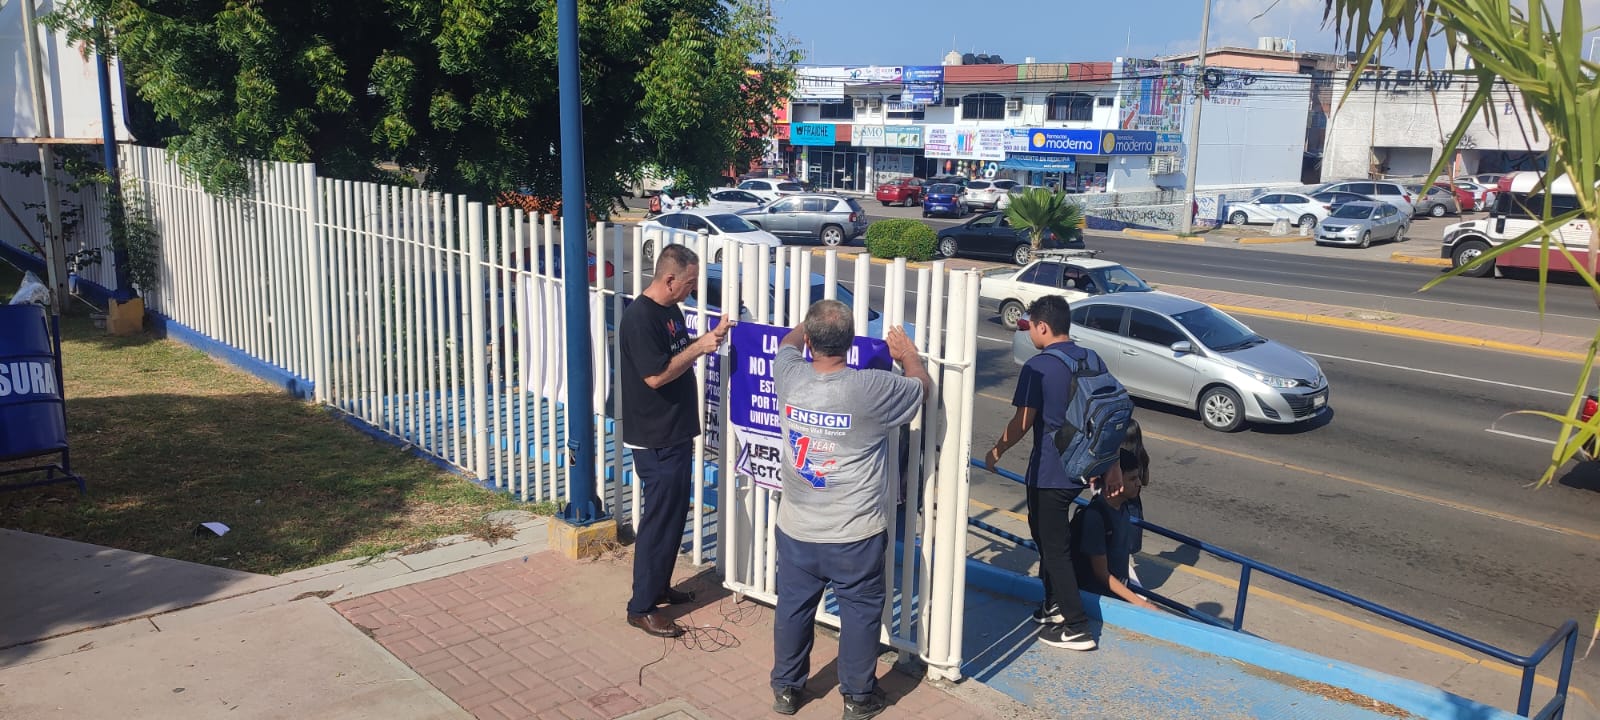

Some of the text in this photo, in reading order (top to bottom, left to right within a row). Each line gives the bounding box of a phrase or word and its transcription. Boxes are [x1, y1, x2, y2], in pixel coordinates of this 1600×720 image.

[1046, 138, 1093, 150] moderna
[1115, 139, 1153, 152] moderna
[749, 356, 765, 376] NO
[760, 379, 777, 395] EST
[751, 394, 769, 410] POR
[790, 408, 848, 427] ENSIGN
[794, 435, 836, 469] 1 YEAR
